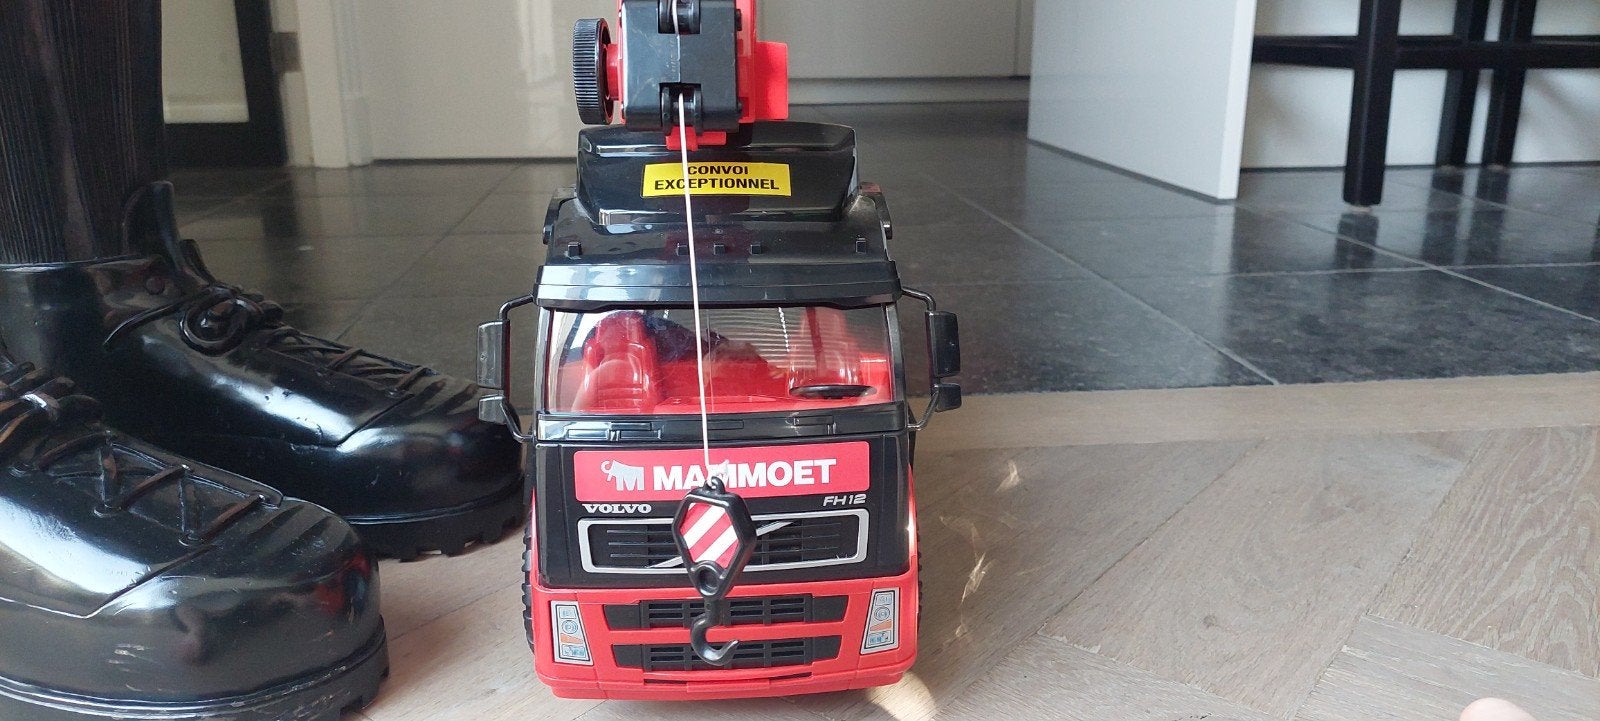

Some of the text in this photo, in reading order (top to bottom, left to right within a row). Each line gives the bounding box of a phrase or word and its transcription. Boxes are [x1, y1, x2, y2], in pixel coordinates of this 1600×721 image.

[688, 165, 748, 175] CONVOI
[654, 178, 779, 190] EXCEPTIONNEL
[582, 503, 652, 514] VOLVO
